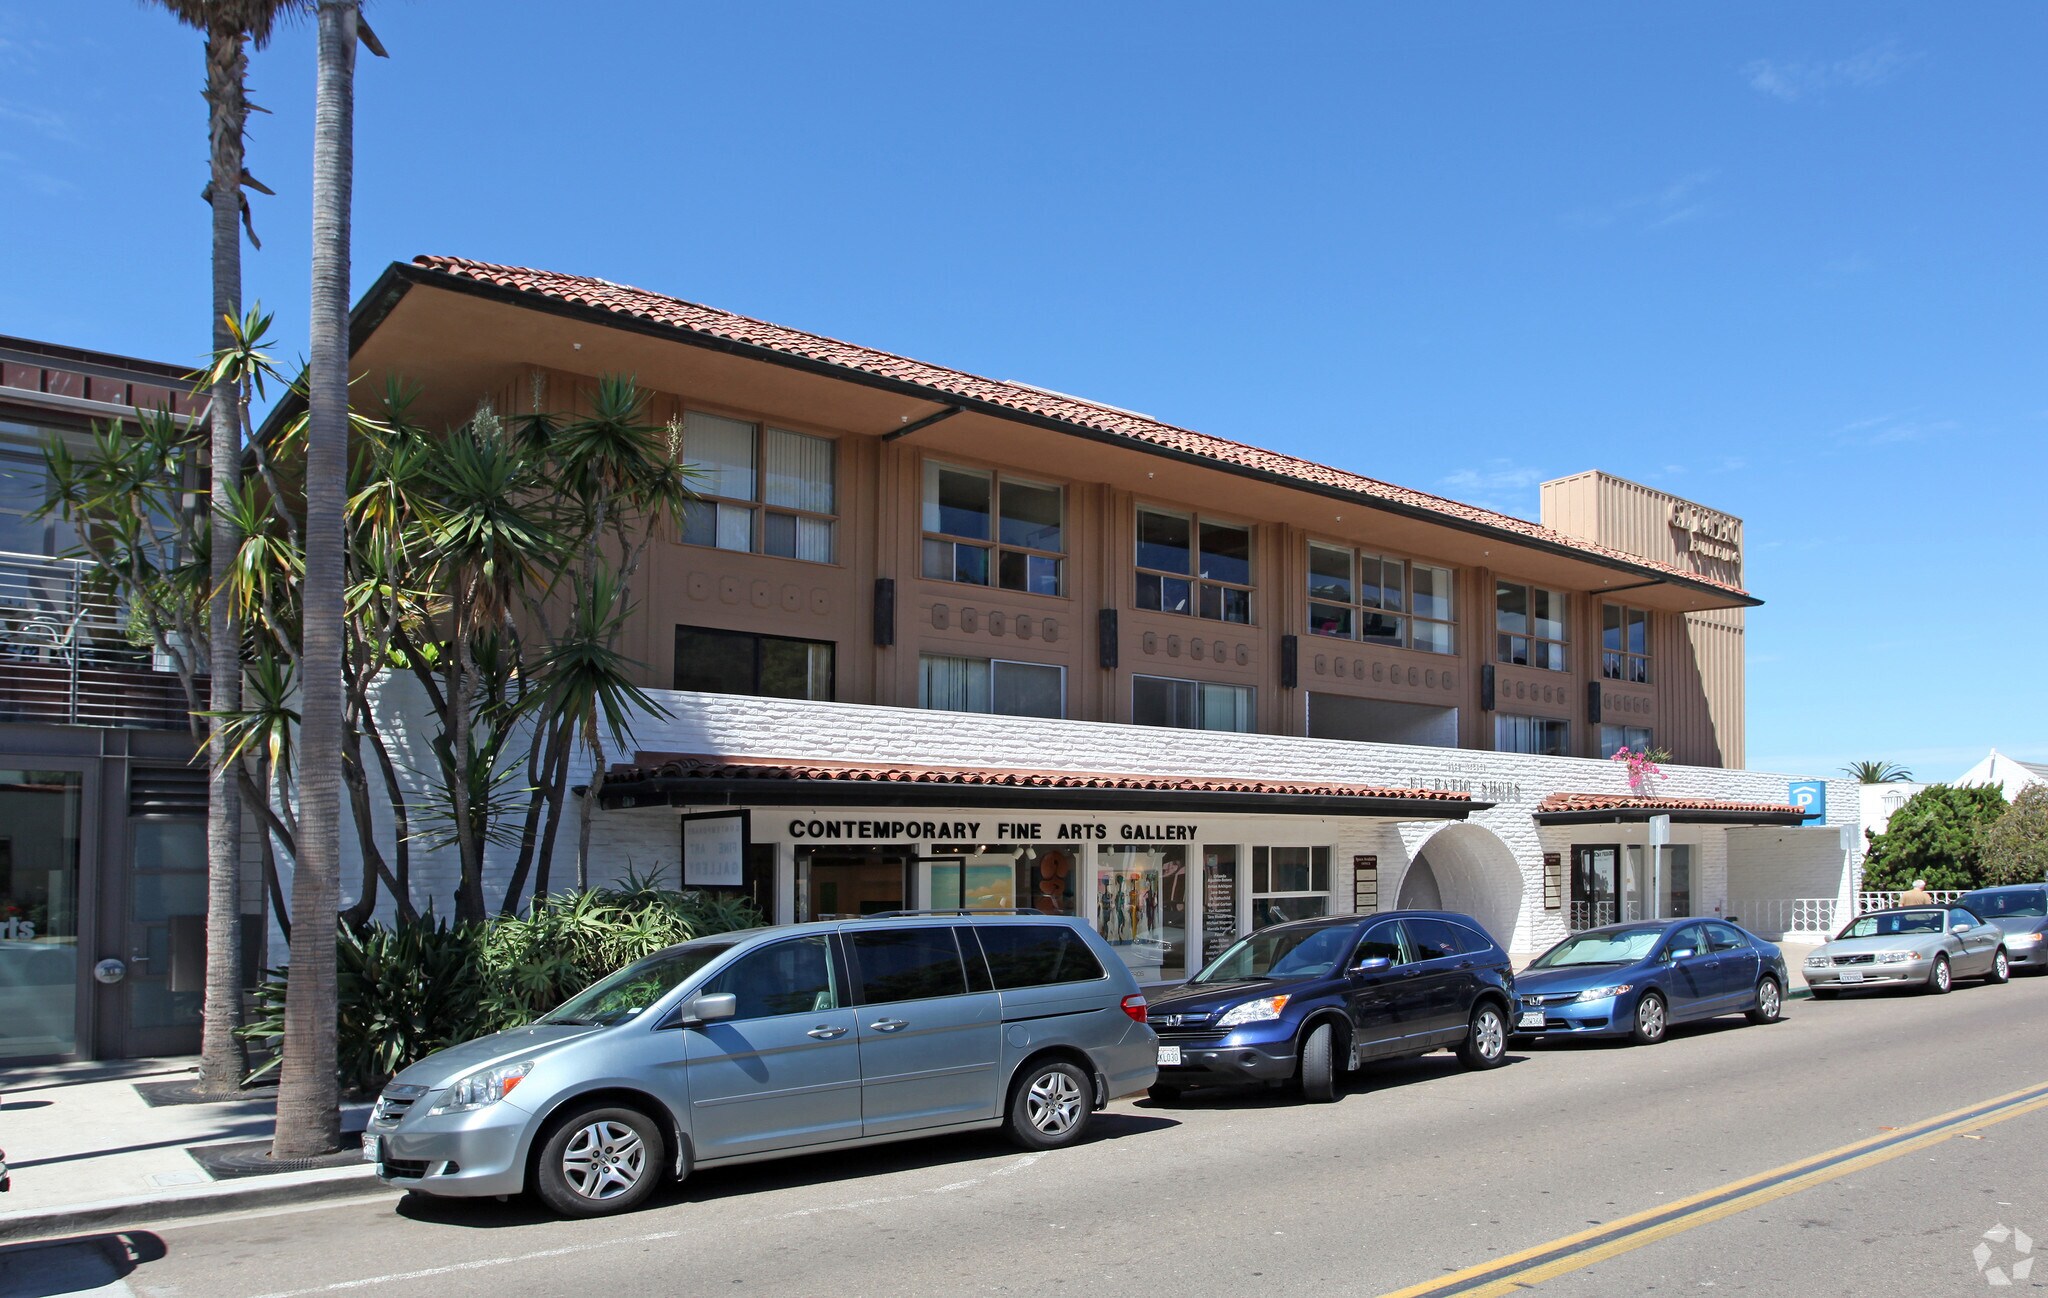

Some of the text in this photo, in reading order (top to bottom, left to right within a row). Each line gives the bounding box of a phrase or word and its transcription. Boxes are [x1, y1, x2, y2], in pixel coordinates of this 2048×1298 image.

[1690, 540, 1740, 563] BUILDING
[1481, 780, 1521, 794] SHOPS
[1797, 793, 1813, 807] P
[789, 820, 1198, 840] CONTEMPORARY FINE ARTS GALLERY
